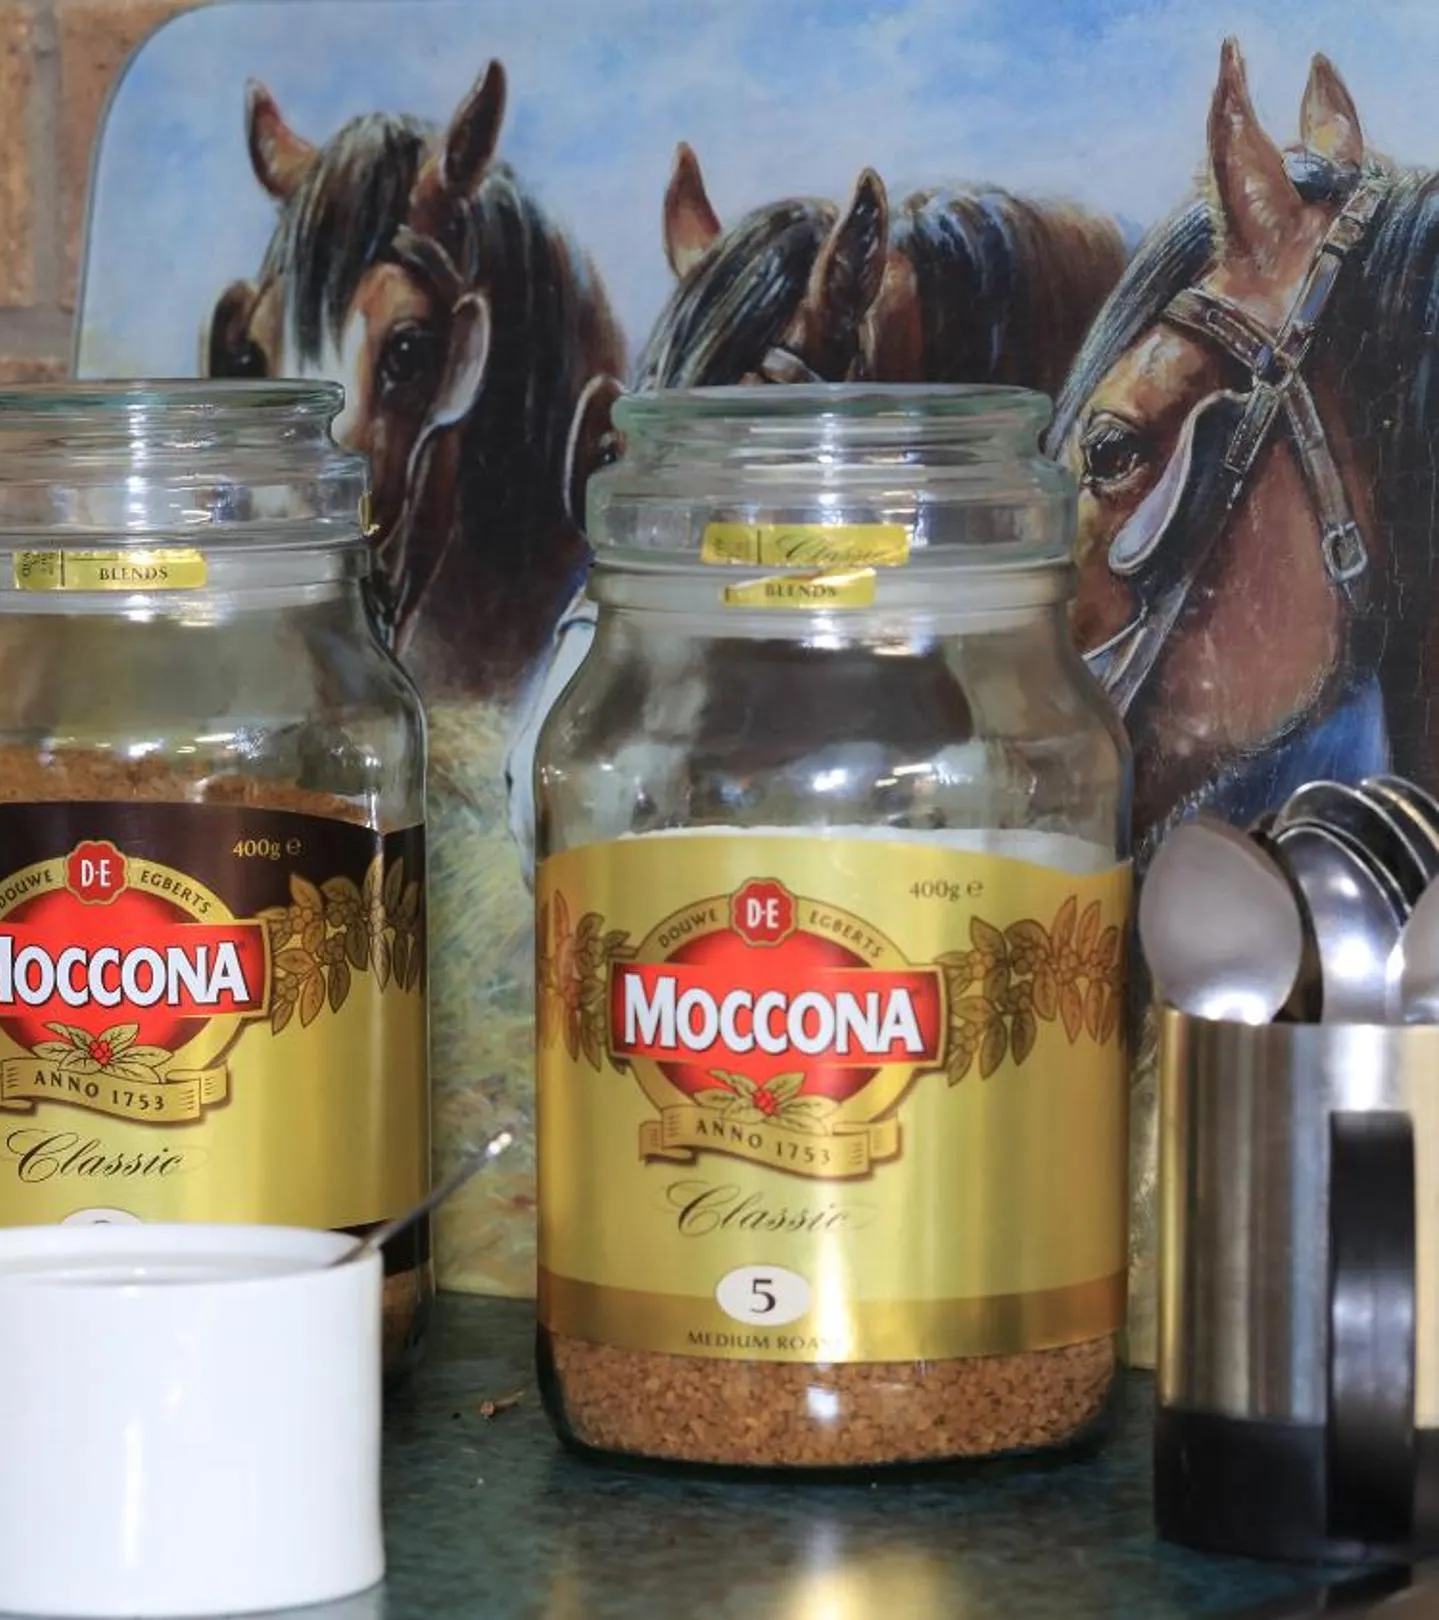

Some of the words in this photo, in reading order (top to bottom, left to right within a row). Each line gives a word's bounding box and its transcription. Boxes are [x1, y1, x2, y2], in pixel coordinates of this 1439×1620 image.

[98, 566, 169, 582] BLENDS
[764, 583, 838, 599] BLENDS
[232, 838, 281, 861] 400g
[140, 868, 212, 915] EGBERTS
[908, 879, 961, 902] 400g
[658, 908, 720, 948] DOUWE
[809, 910, 885, 959] EGBERTS
[623, 973, 926, 1055] MOCCONA
[33, 1070, 100, 1099] ANNO
[111, 1089, 166, 1112] 1753
[2, 1128, 186, 1184] Classic
[694, 1117, 763, 1149] ANNO
[775, 1138, 832, 1165] 1753
[665, 1179, 852, 1238] Classic
[750, 1278, 777, 1314] 5
[686, 1330, 770, 1350] MEDIUM
